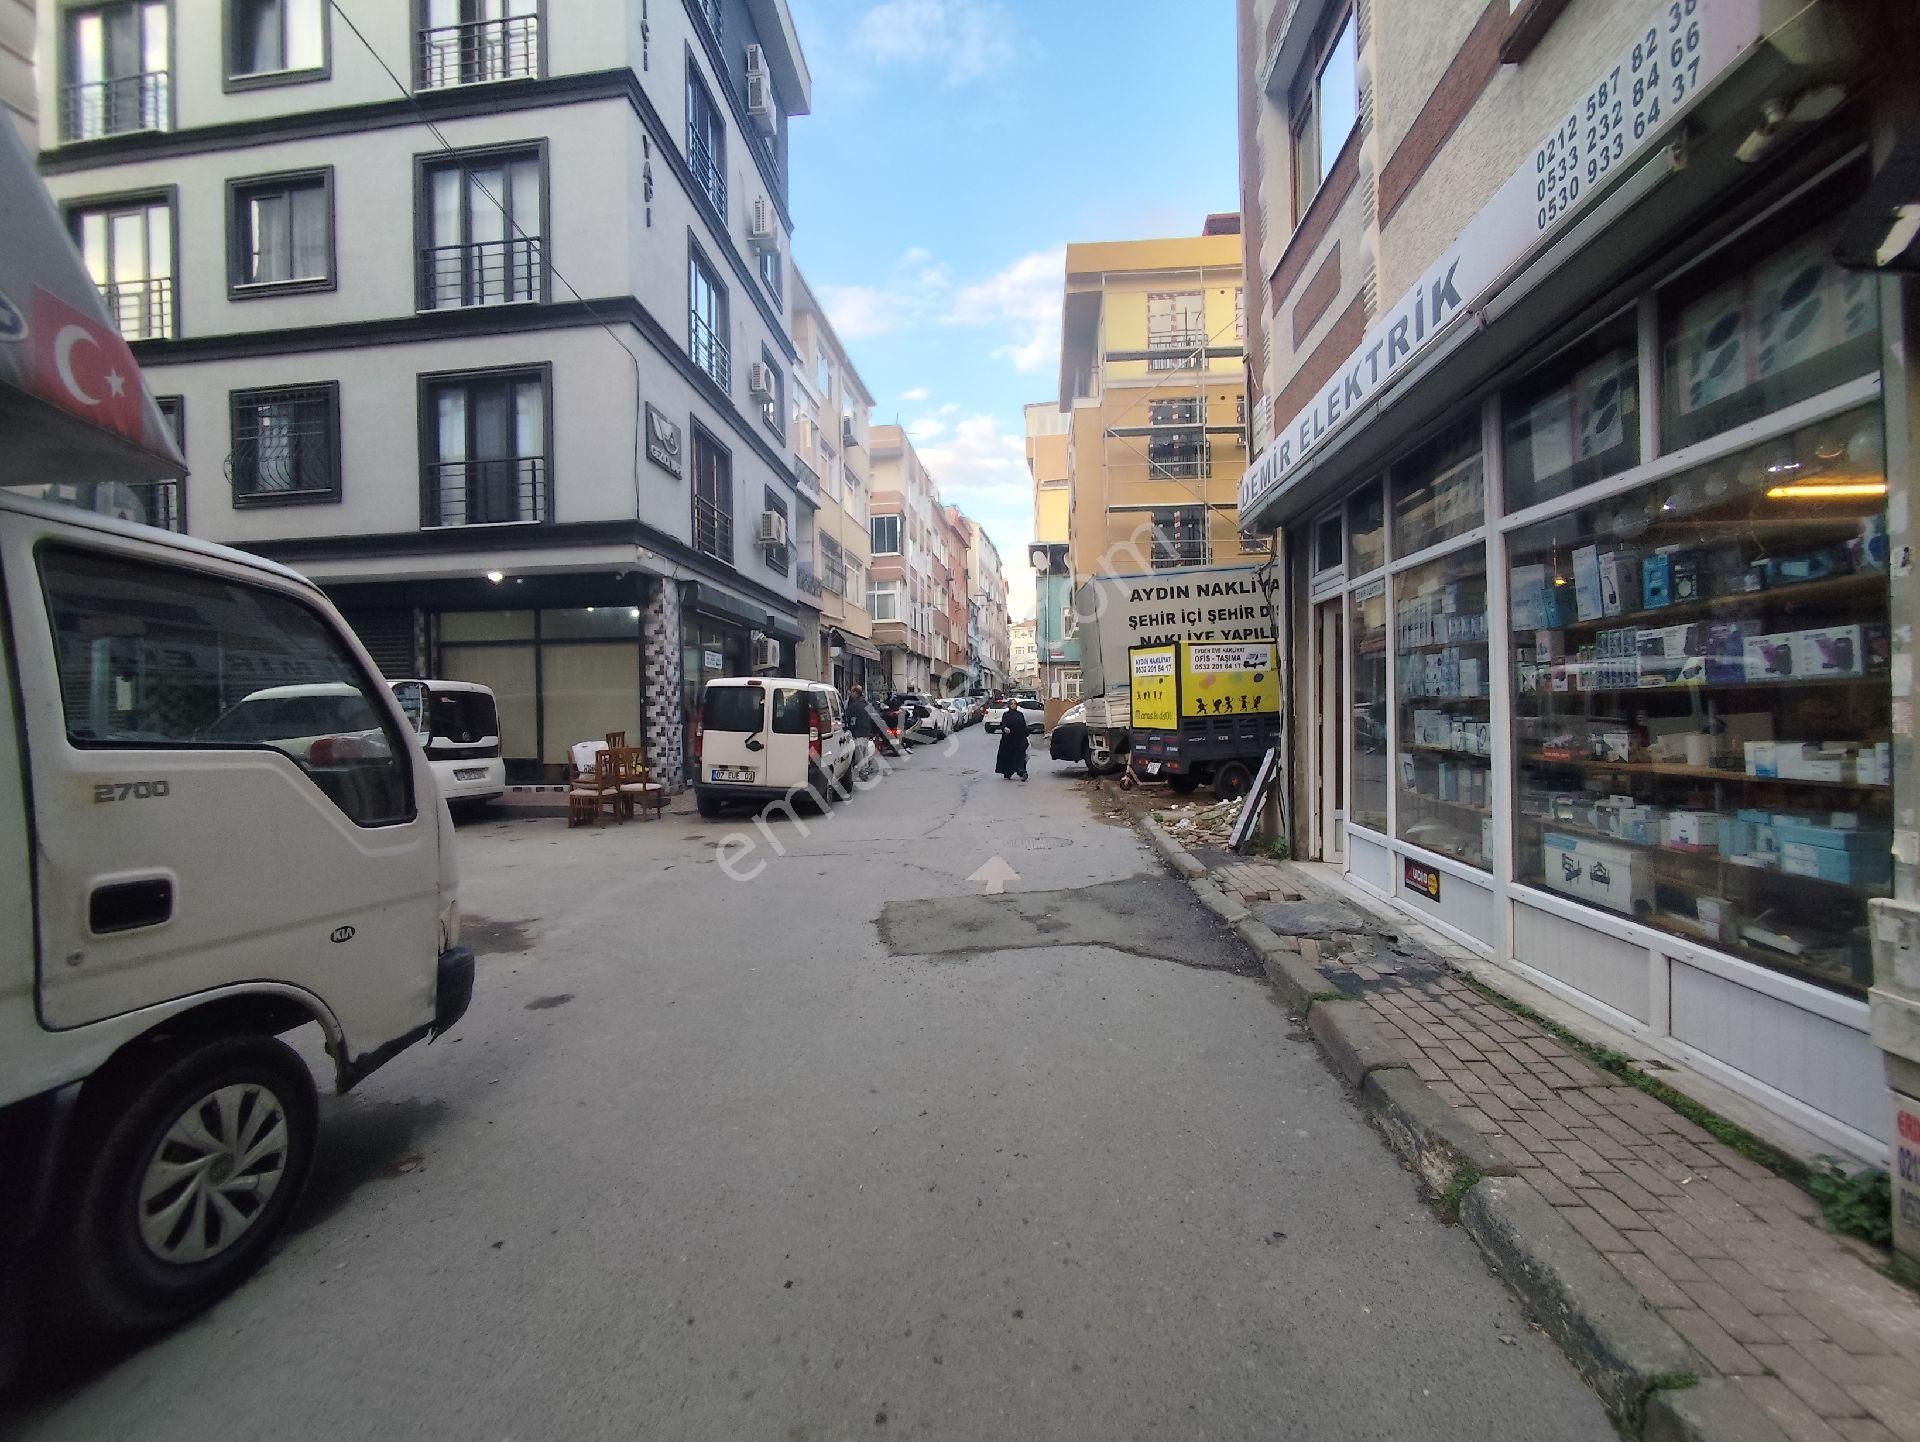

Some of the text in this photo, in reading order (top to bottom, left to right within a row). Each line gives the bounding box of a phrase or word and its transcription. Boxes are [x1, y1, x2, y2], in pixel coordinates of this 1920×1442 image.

[1537, 115, 1577, 173] 0212
[1586, 65, 1620, 121] 587
[1632, 28, 1657, 73] 82
[1537, 21, 1699, 201] 0533 232 84 66
[1537, 55, 1700, 229] 0530 933 64 37
[1242, 255, 1462, 508] DEMİR ELEKTRİK
[1130, 577, 1279, 602] AYDIN NAKLİYA
[1129, 610, 1177, 630] ŞEHİR
[1181, 608, 1202, 626] İÇİ
[1207, 604, 1255, 625] ŞEHİR
[1220, 626, 1279, 640] YAPILI
[1194, 654, 1211, 662] OFİS
[1216, 654, 1241, 663] TAŞIMA
[95, 781, 170, 803] 2700
[333, 927, 353, 941] KIA
